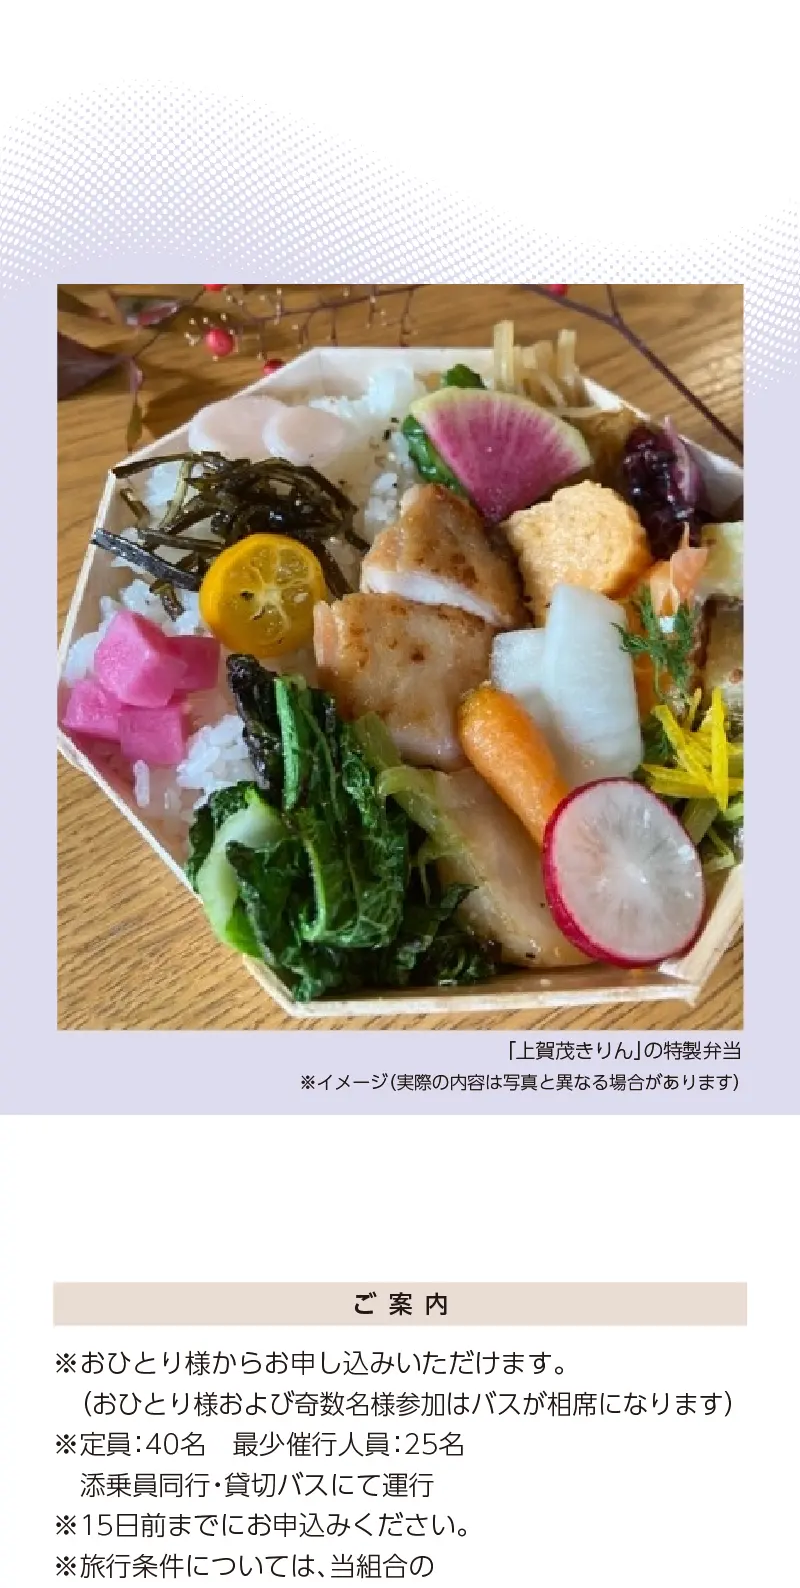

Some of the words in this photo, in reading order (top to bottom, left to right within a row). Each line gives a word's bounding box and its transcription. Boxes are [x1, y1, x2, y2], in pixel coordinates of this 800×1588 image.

[510, 1041, 740, 1060] 「上賀茂きりん」の特製弁当
[56, 1350, 563, 1375] ※おひとり様からお申し込みいただけます。
[81, 1471, 434, 1497] 添乗員同行・貸切バスにて運行
[56, 1512, 466, 1537] ※15日前までにお申込みください。
[56, 1554, 433, 1578] ※旅行条件については、当組合の
